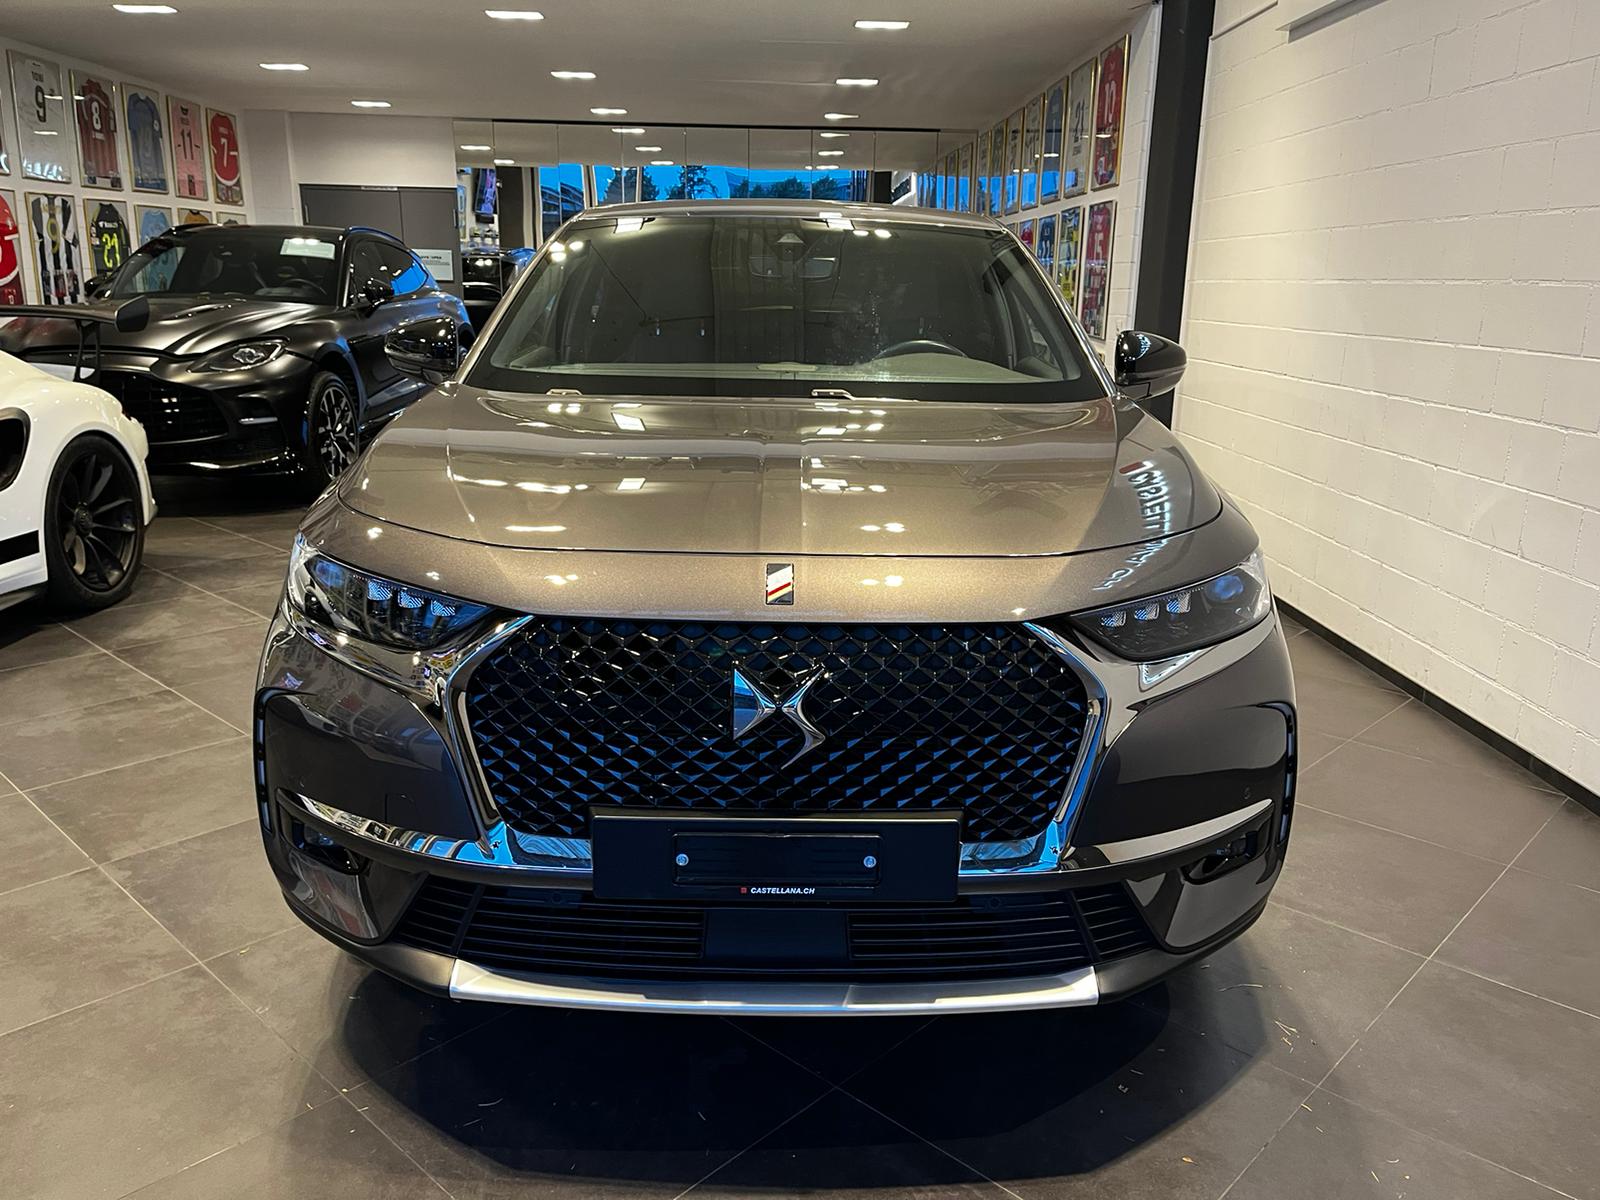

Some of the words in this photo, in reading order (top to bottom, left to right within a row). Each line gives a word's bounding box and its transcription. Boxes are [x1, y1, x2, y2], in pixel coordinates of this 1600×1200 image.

[35, 85, 47, 123] 9
[91, 101, 102, 130] 8
[180, 129, 194, 160] 11
[221, 138, 228, 168] 7
[102, 232, 121, 269] 21
[750, 887, 815, 895] CASTELLANA.CH
